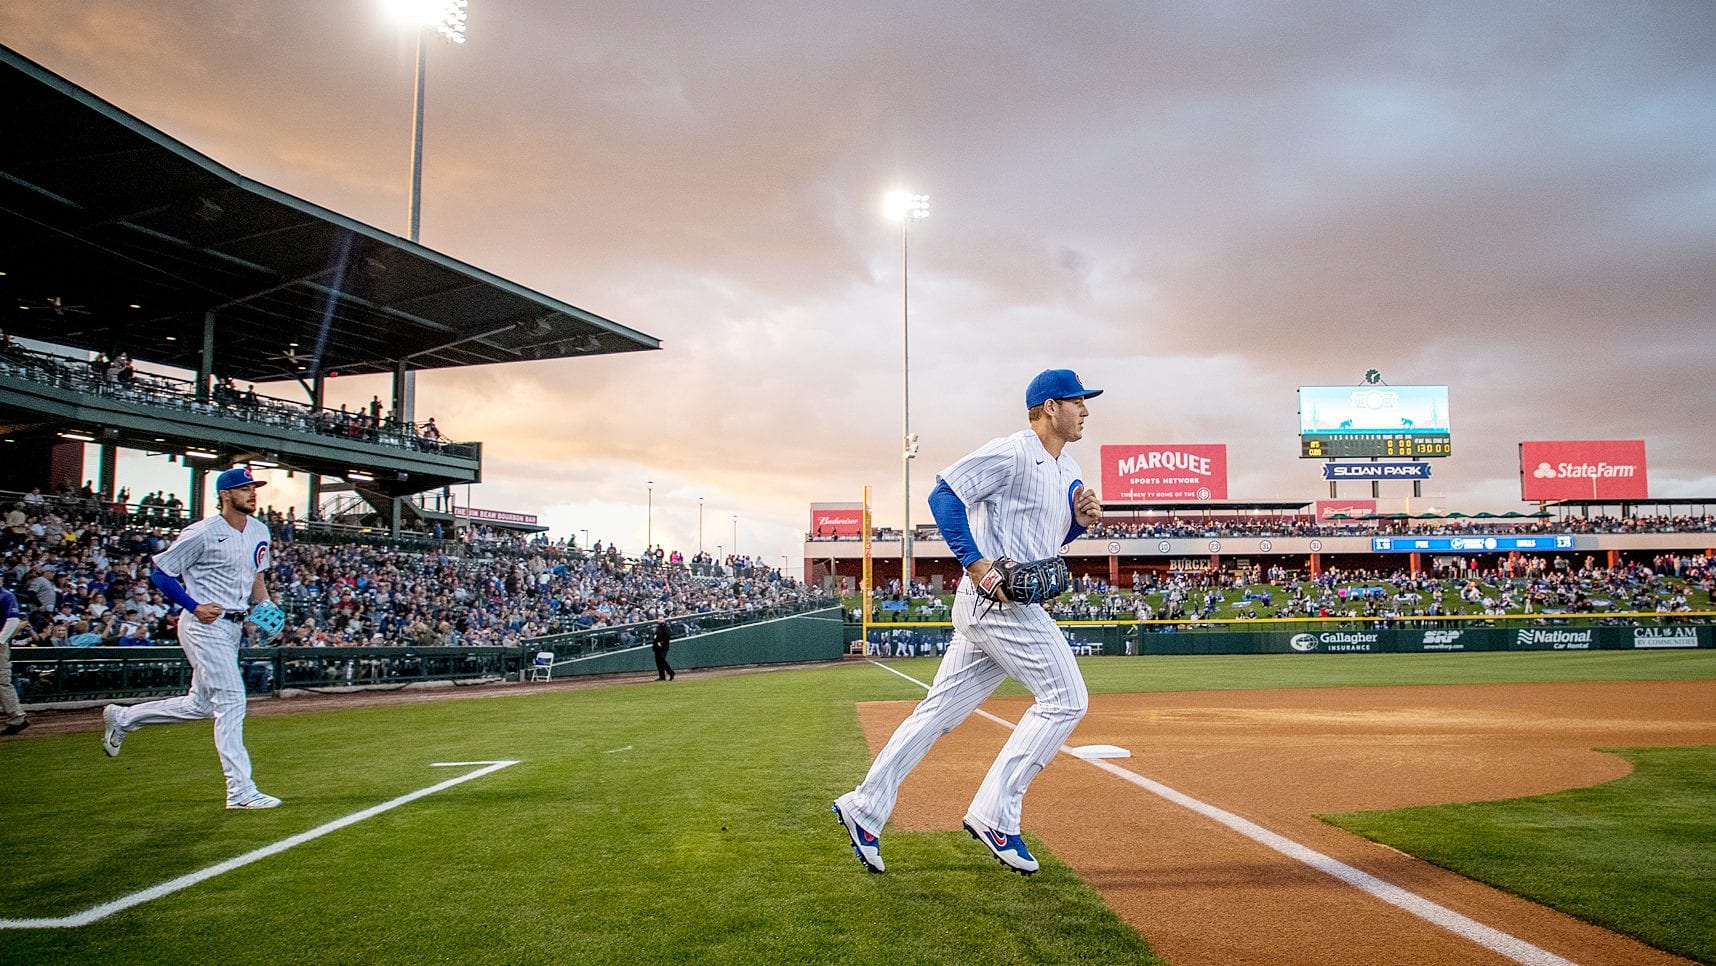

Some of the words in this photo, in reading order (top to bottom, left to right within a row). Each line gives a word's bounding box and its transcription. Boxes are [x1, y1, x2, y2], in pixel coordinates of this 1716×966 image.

[1118, 451, 1211, 476] MARQUEE
[1334, 467, 1381, 475] SLOAN
[1384, 466, 1420, 475] PARK
[818, 516, 858, 525] Budweiser
[1320, 632, 1378, 644] Gallagher
[1423, 630, 1460, 643] SRP
[1534, 630, 1591, 642] National
[1634, 628, 1662, 638] CAL
[1675, 627, 1696, 637] AM
